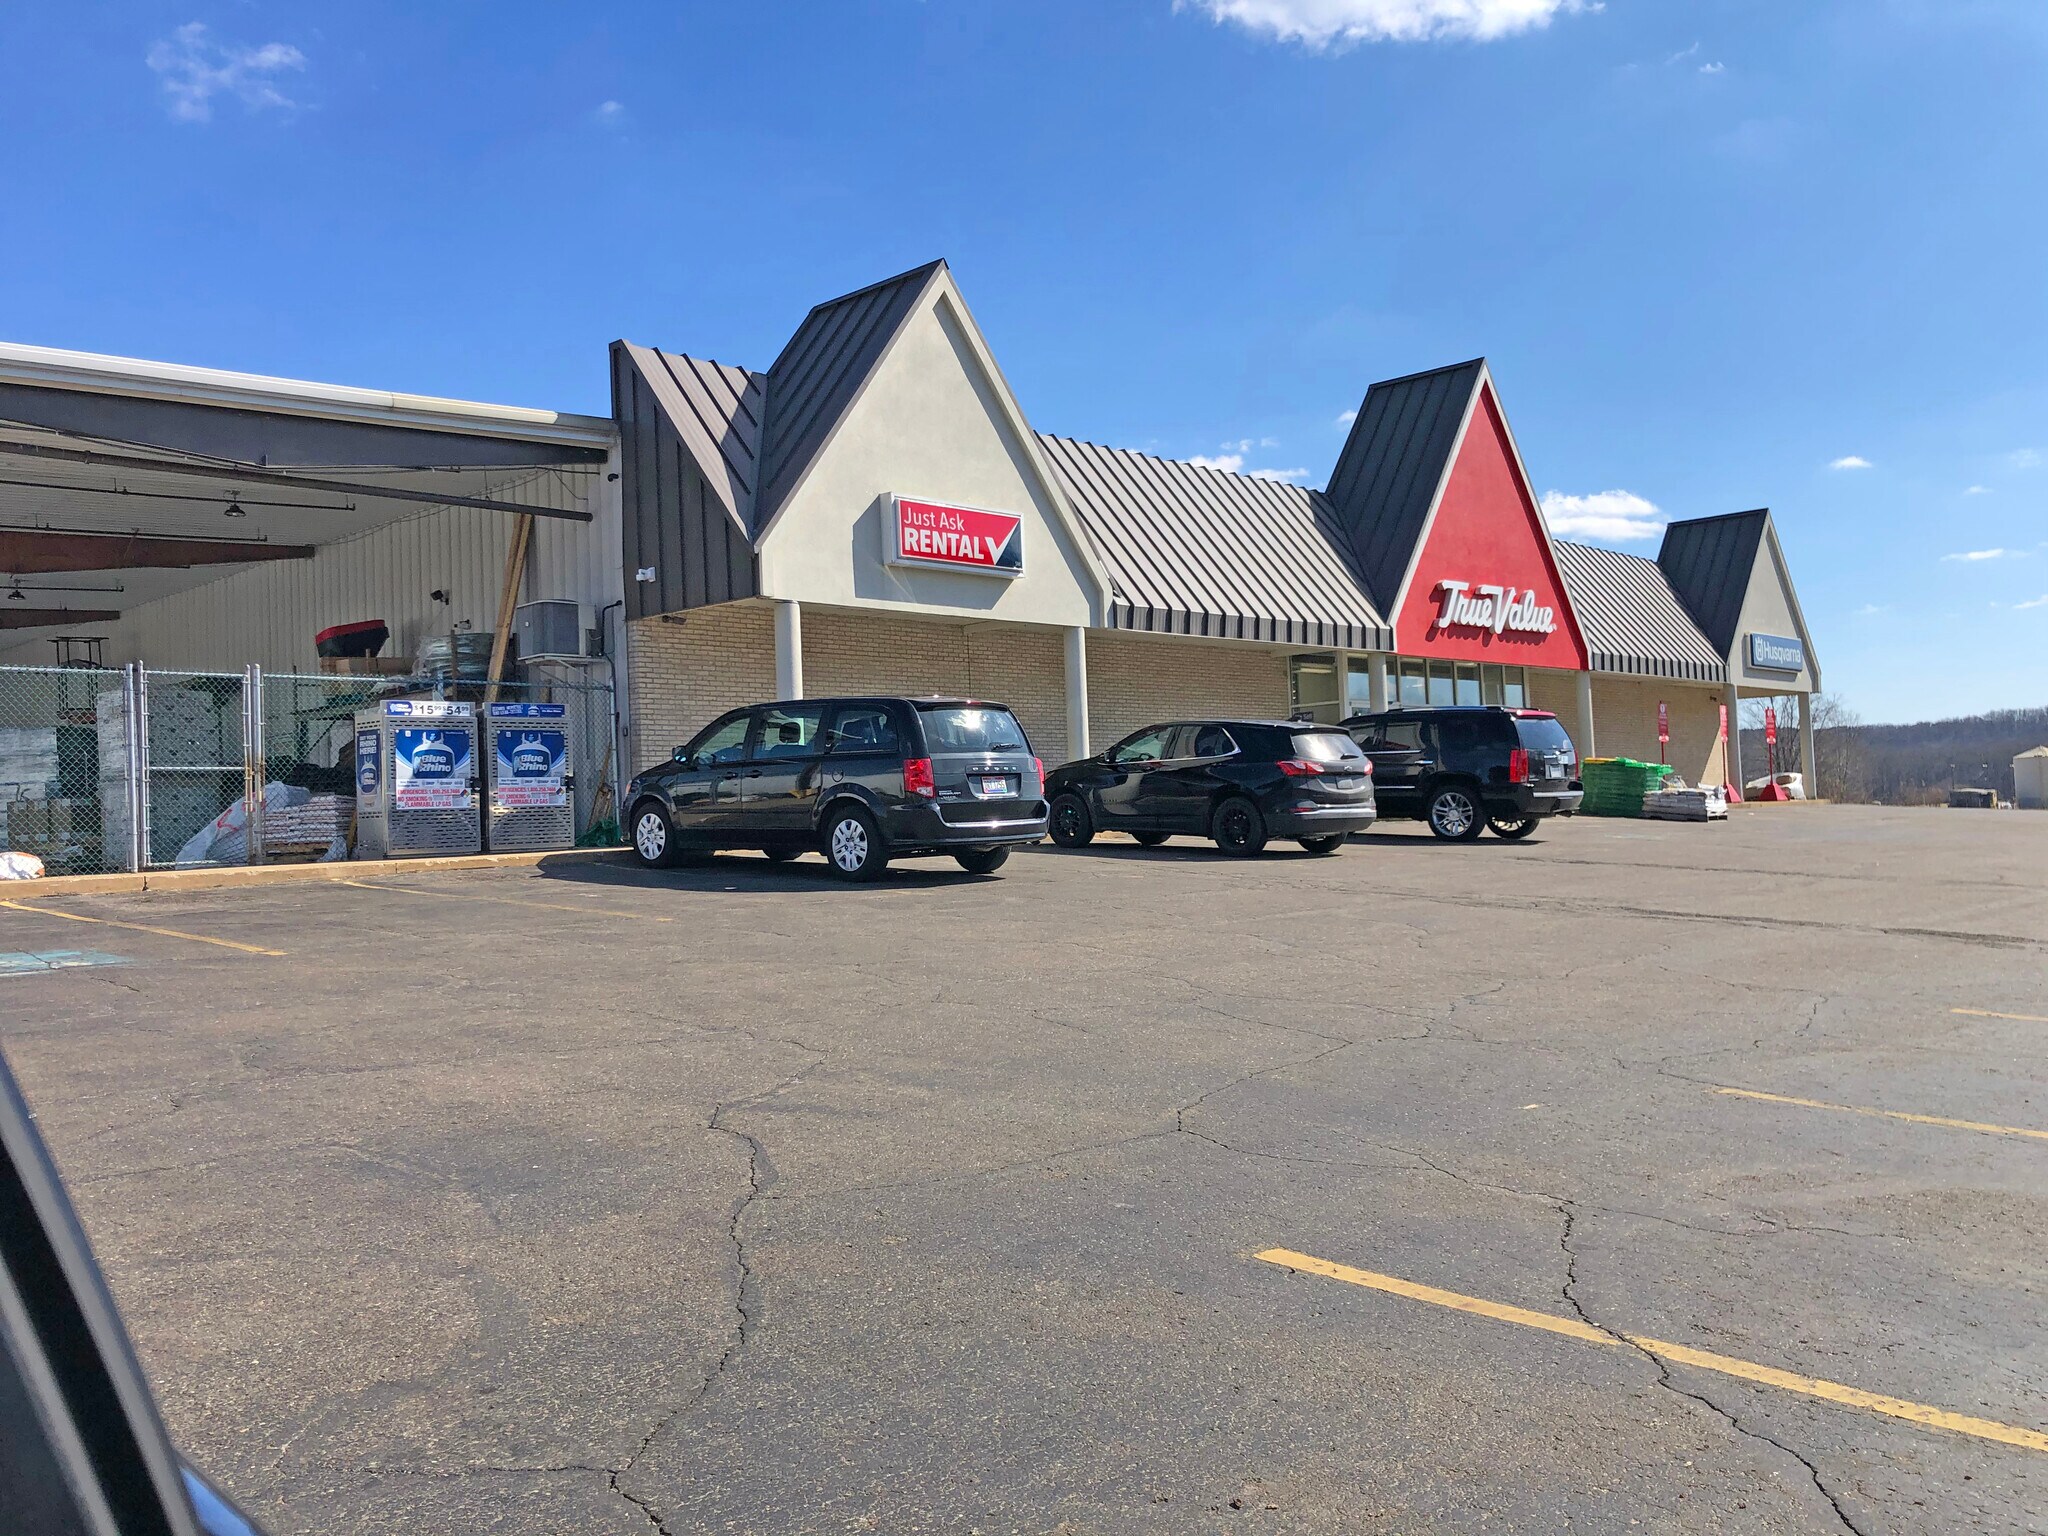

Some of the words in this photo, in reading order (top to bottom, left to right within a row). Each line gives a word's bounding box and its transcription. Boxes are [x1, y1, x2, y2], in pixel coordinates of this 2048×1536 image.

[904, 507, 936, 528] Just
[939, 512, 965, 531] Ask
[904, 527, 985, 560] RENTAL
[1763, 640, 1801, 664] Husqvarna
[422, 754, 447, 763] Blue
[521, 754, 544, 763] Blue
